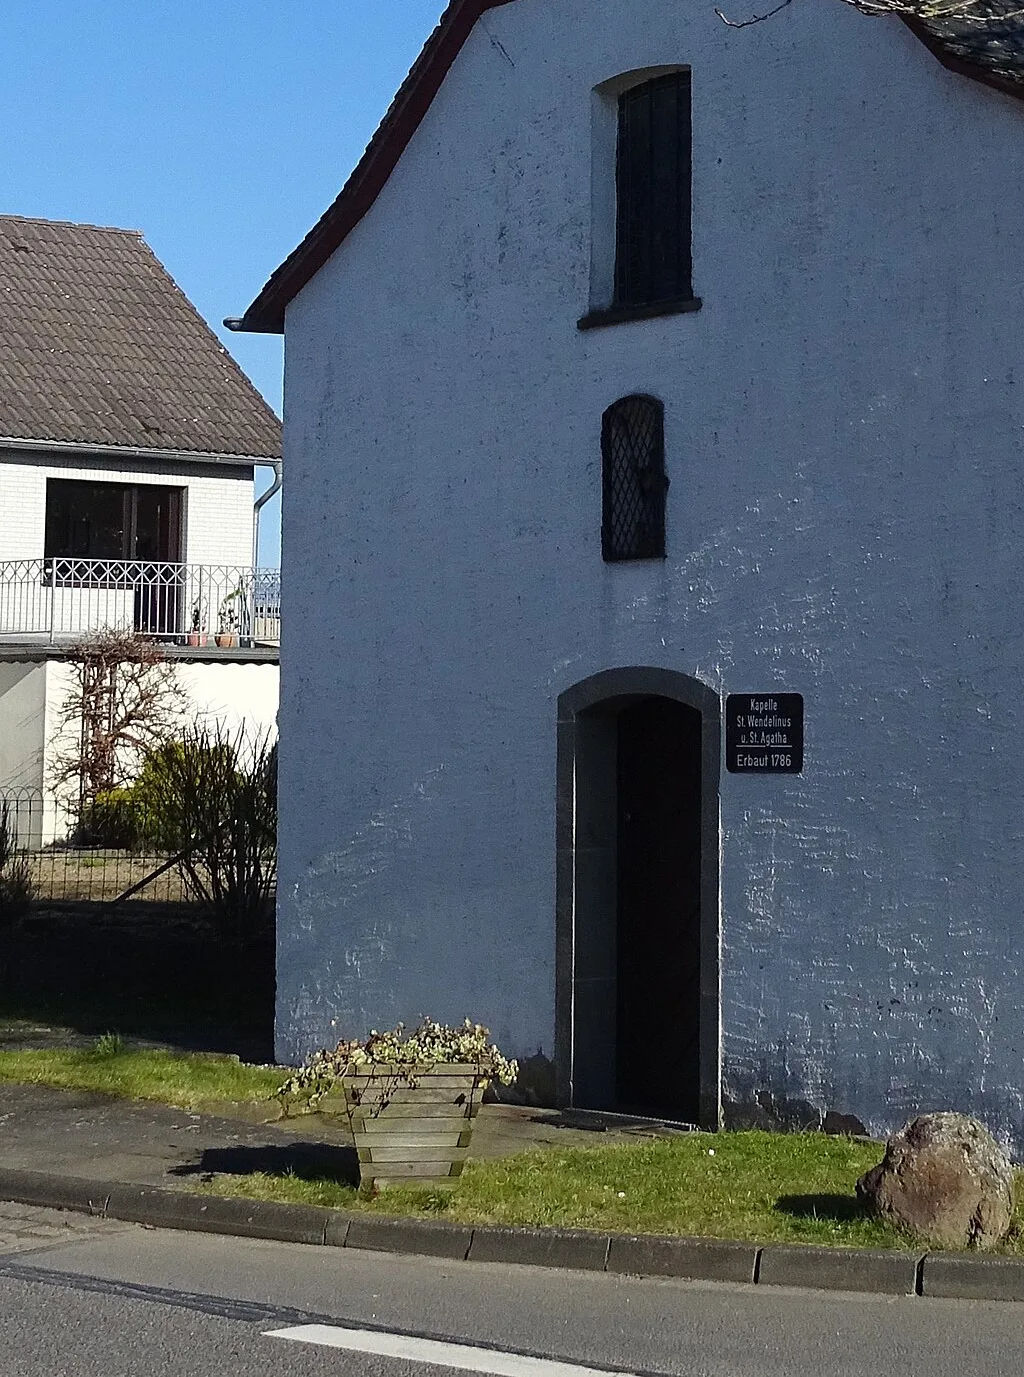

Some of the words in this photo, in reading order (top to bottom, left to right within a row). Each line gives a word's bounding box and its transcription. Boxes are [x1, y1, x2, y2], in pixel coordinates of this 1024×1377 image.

[750, 698, 777, 714] Kapelle
[736, 715, 746, 728] St.
[747, 715, 792, 728] Wendelinus
[741, 734, 748, 743] u.
[749, 731, 759, 743] St.
[760, 731, 787, 746] Agatha
[737, 754, 768, 767] Erbaut
[771, 754, 792, 767] 1786
